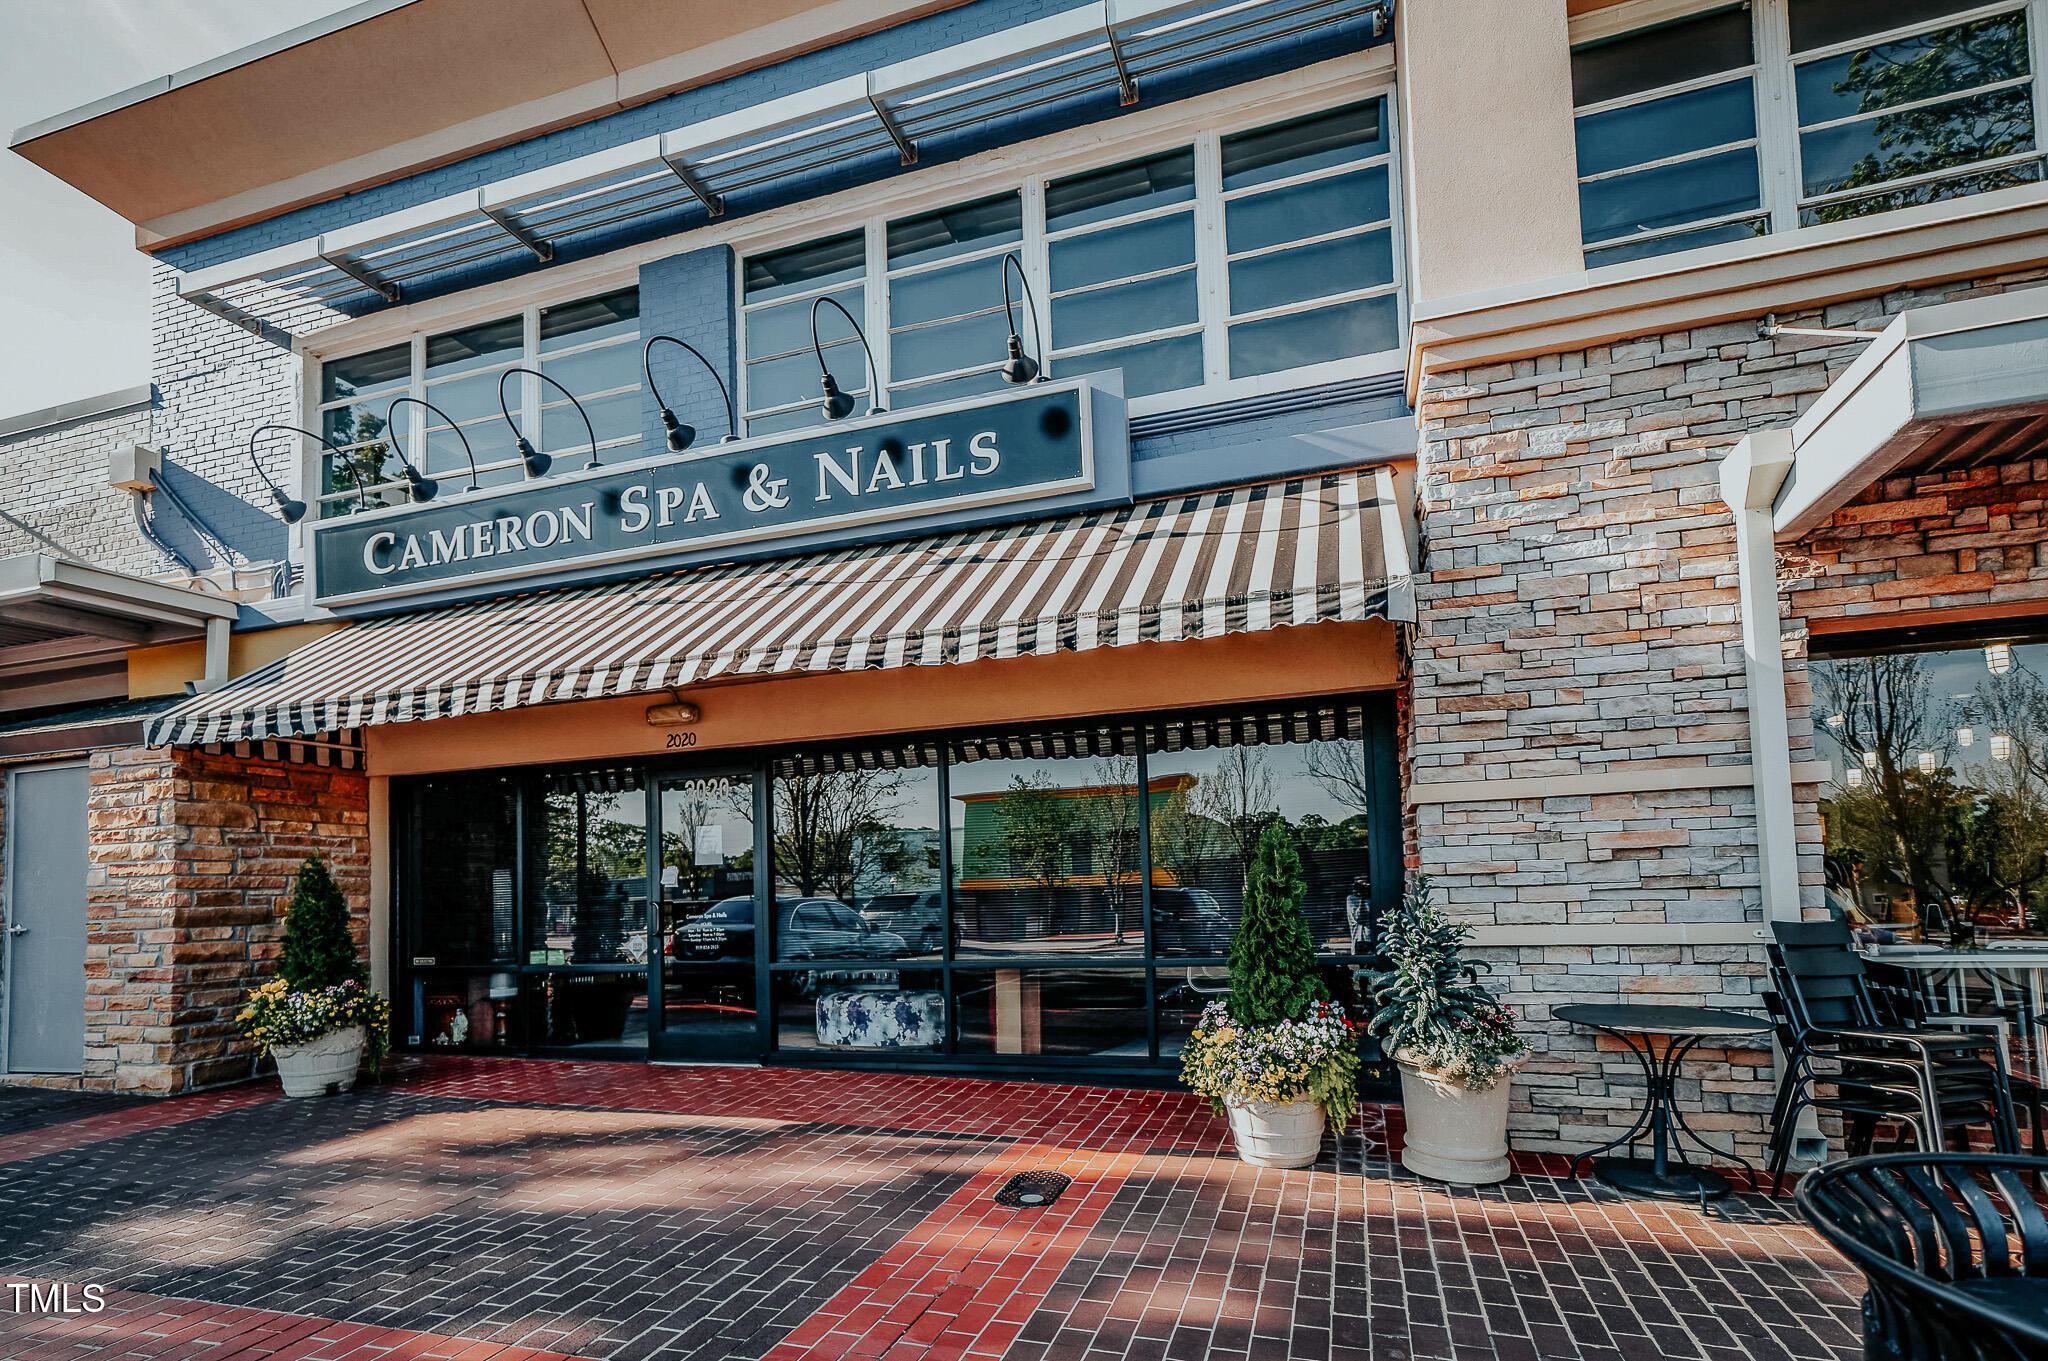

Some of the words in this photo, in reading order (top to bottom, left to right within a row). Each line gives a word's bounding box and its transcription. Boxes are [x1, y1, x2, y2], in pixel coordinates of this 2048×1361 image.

[363, 502, 595, 575] CAMERON
[620, 481, 721, 534] SPA
[742, 463, 791, 513] &
[814, 431, 1001, 502] NAILS
[666, 732, 697, 748] 2020
[684, 777, 729, 803] 2020
